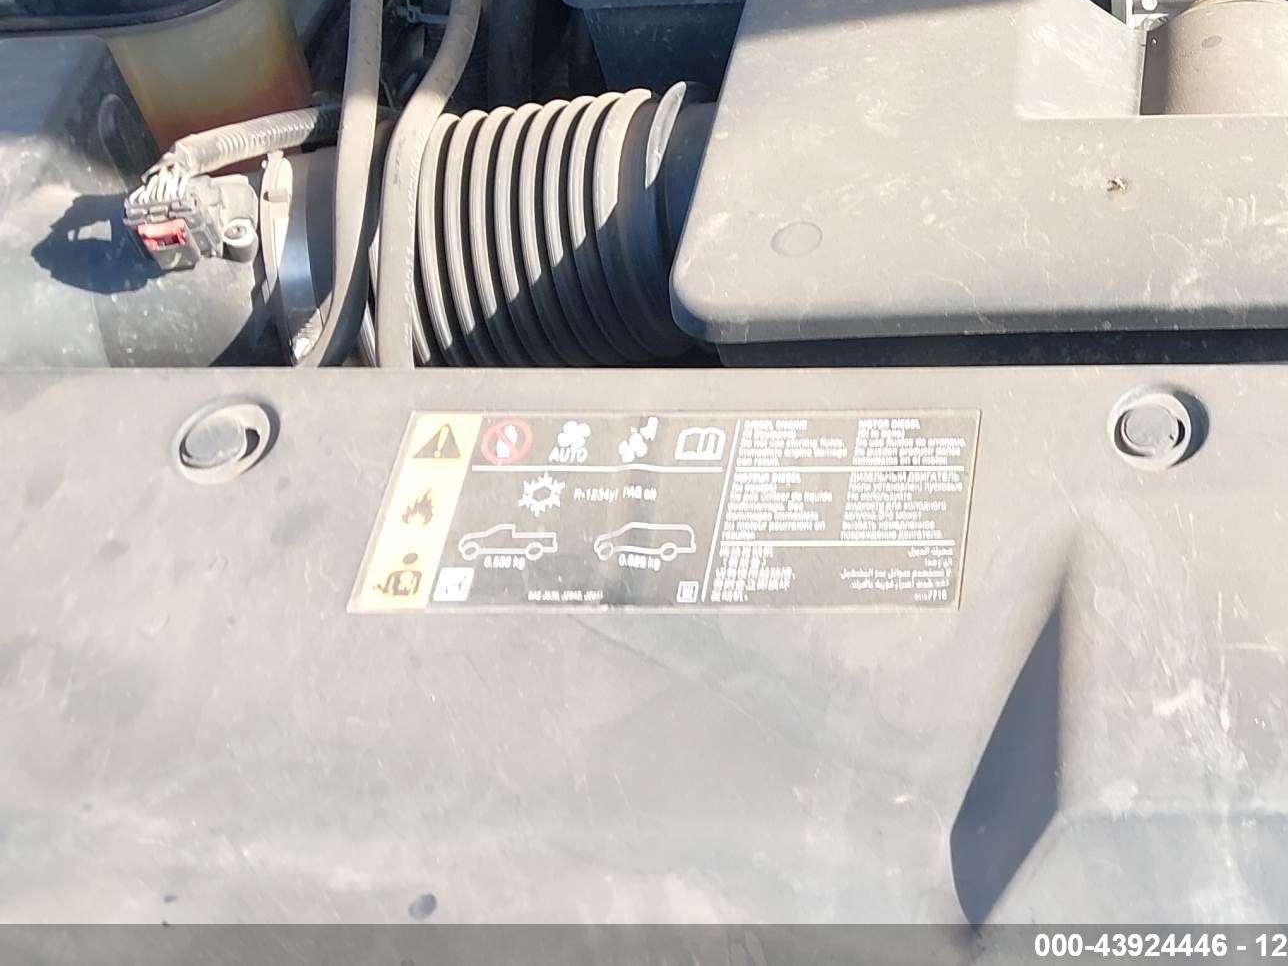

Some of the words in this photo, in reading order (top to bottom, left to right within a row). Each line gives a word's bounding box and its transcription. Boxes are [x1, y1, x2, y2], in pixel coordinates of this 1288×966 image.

[548, 448, 588, 464] AUTO
[513, 556, 526, 571] kg
[648, 555, 661, 571] kg
